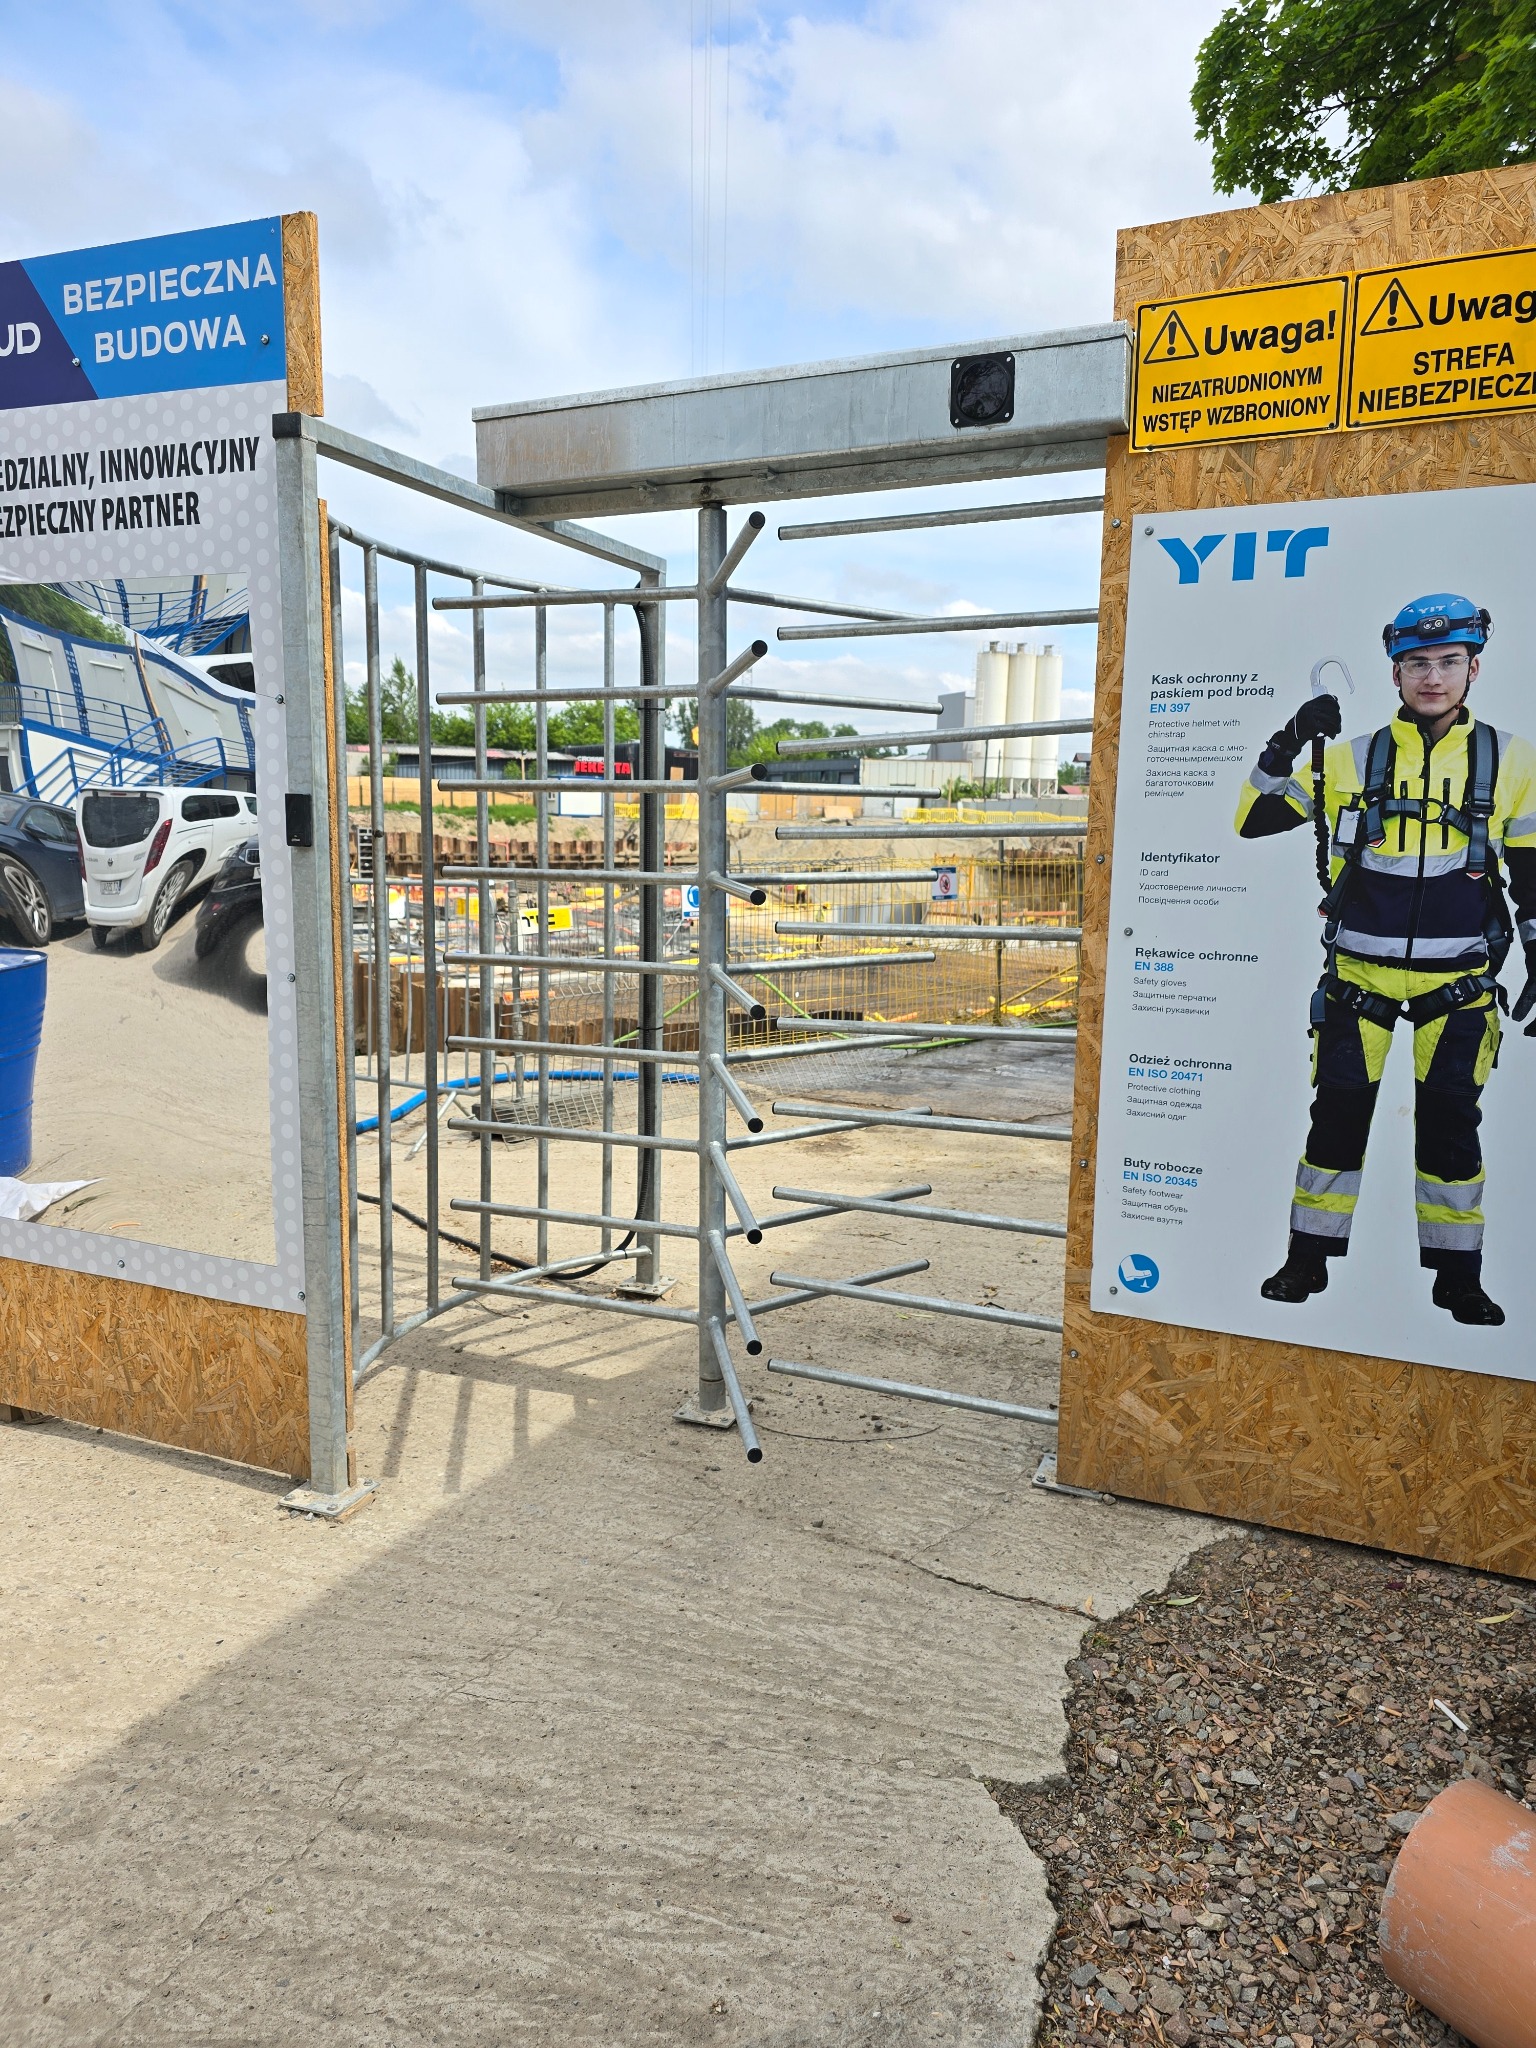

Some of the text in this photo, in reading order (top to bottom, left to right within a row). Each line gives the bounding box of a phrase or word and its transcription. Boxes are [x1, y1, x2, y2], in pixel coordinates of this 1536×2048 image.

[63, 253, 277, 315] BEZPIECZNA
[1429, 290, 1536, 325] Uwag
[94, 314, 246, 363] BUDOWA
[1204, 310, 1336, 356] Uwaga!
[1413, 342, 1515, 376] STREFA
[1152, 366, 1323, 403] NIEZATRUDNIONYM
[1357, 371, 1536, 413] NIEBEZPIECZ
[1143, 395, 1330, 434] WSTĘP WZBRONIONY
[101, 436, 260, 484] INNOWACYJNY
[102, 491, 200, 531] PARTNER
[1157, 526, 1330, 584] YIT
[1418, 605, 1446, 614] YIT
[1151, 673, 1259, 685] Kask ochronny z
[1150, 685, 1275, 701] paskiem pod brodą
[1150, 703, 1191, 713] EN 397
[1148, 719, 1241, 728] Protective helmet with
[1148, 731, 1186, 739] chinstrap
[1147, 744, 1190, 753] Защитная
[1145, 769, 1181, 777] Захисна
[1145, 779, 1214, 787] багатоточковим
[1140, 852, 1221, 865] Identyfikator
[1150, 869, 1169, 877] card
[1139, 883, 1247, 893] Удостоверение личности
[1138, 896, 1220, 906] Посвідчення особи
[1135, 947, 1258, 963] Rękawice ochronne
[1134, 961, 1174, 972] EN 388
[1133, 976, 1187, 987] Safety gloves
[1132, 990, 1217, 1003] Защитные перчатки
[1131, 1004, 1210, 1016] Захисні рукавички
[1129, 1053, 1232, 1071] Odzież ochronna
[1128, 1067, 1203, 1082] EN ISO 20471
[1127, 1083, 1201, 1097] Protective clothing
[1126, 1096, 1203, 1110] Защитная одежда
[1126, 1109, 1166, 1119] Захисний
[1123, 1157, 1203, 1175] Buty robocze
[1123, 1170, 1198, 1187] EN ISO 20345
[1122, 1185, 1184, 1199] Safety footwear
[1121, 1198, 1189, 1213] Защитная обувь
[1120, 1211, 1183, 1225] Захисне взуття
